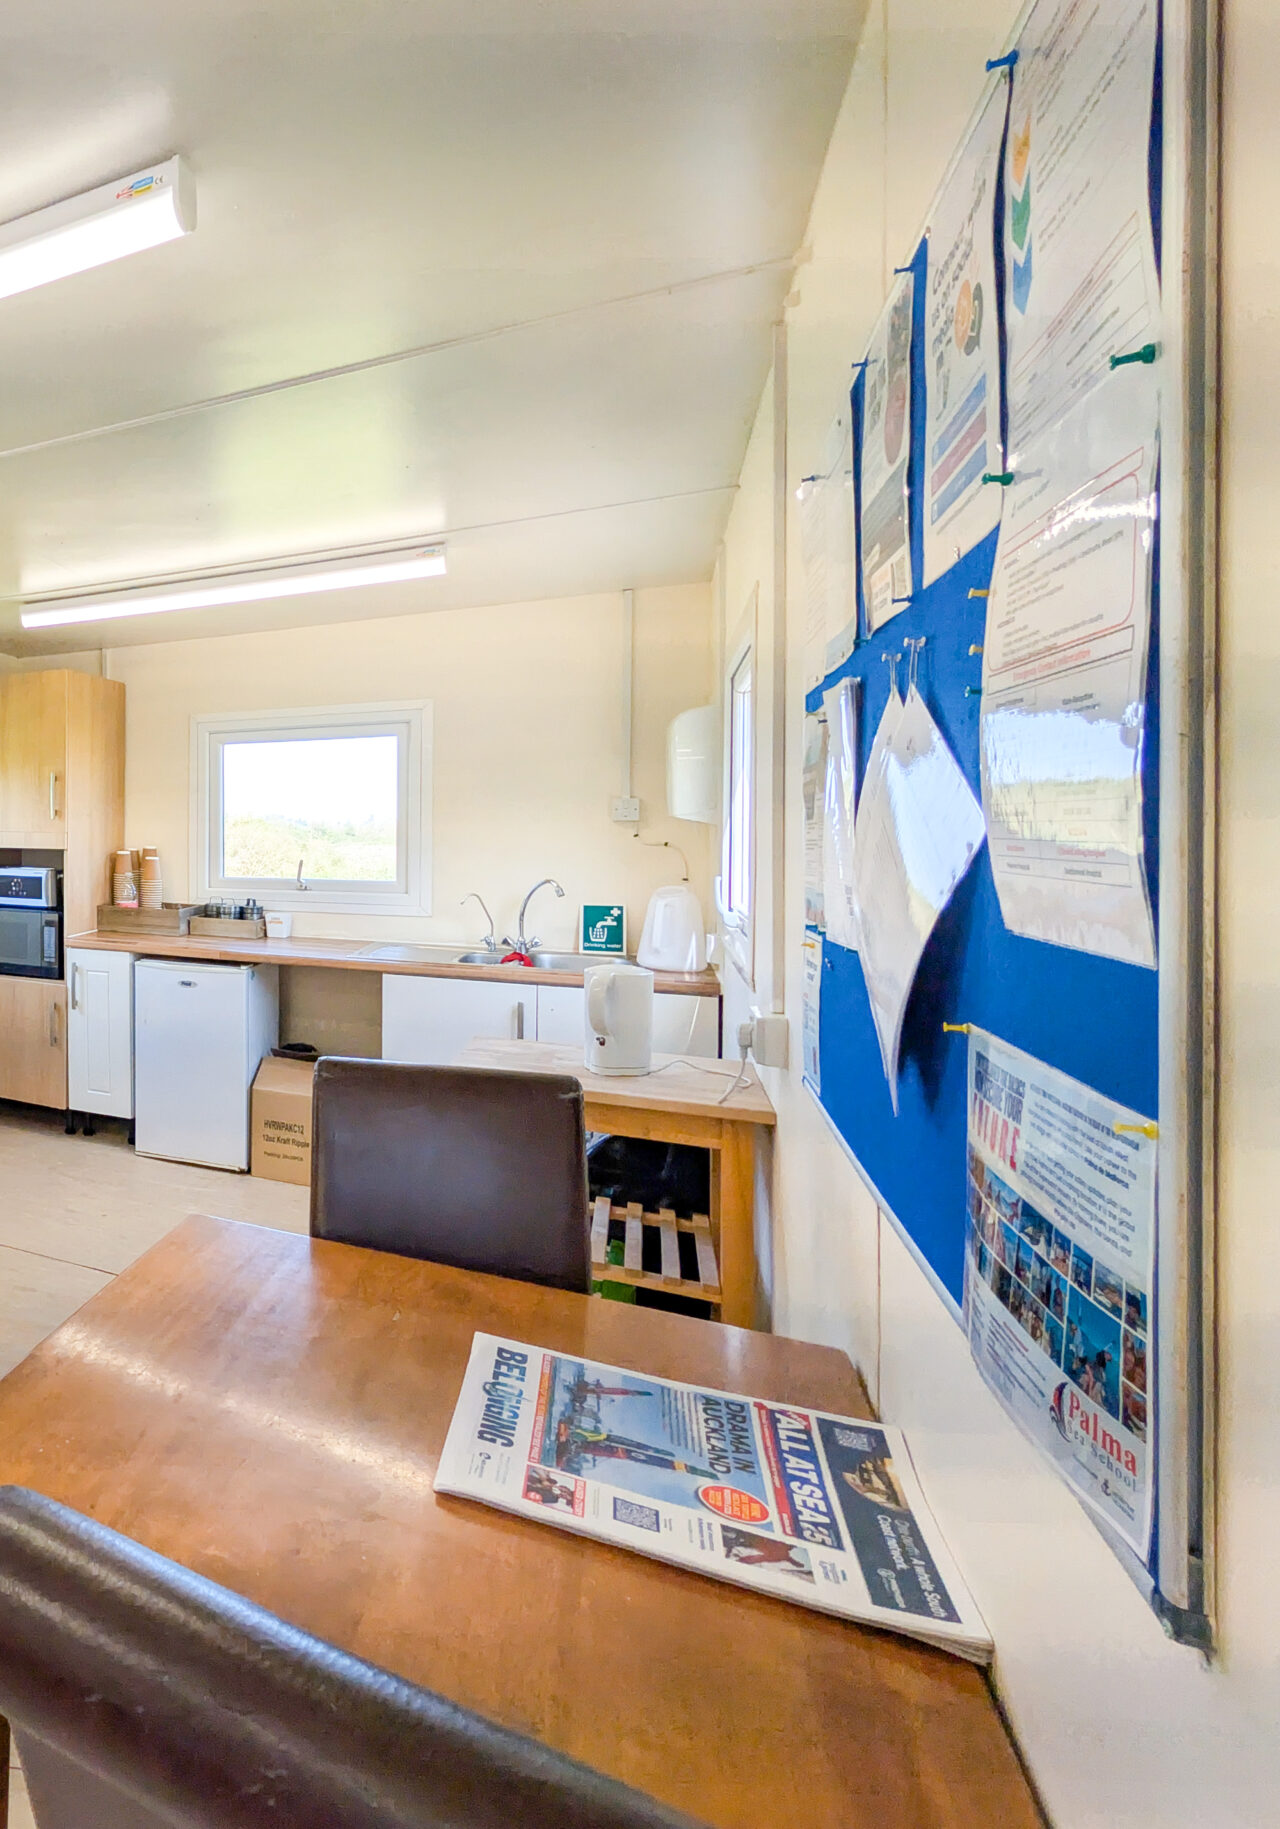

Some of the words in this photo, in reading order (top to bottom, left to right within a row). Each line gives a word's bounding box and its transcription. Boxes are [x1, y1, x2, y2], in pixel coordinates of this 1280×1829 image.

[477, 1346, 528, 1448] BELONGING
[701, 1395, 731, 1474] AUCKLAND
[724, 1400, 752, 1455] DRAMA
[774, 1412, 811, 1451] ALL
[1069, 1388, 1137, 1477] Palma
[732, 1456, 757, 1475] IN
[783, 1453, 820, 1485] AT
[1067, 1420, 1085, 1446] Sea
[1091, 1442, 1136, 1492] School
[790, 1481, 831, 1524] SEA
[877, 1514, 896, 1537] Coast
[913, 1565, 935, 1591] whole
[924, 1591, 947, 1618] South
